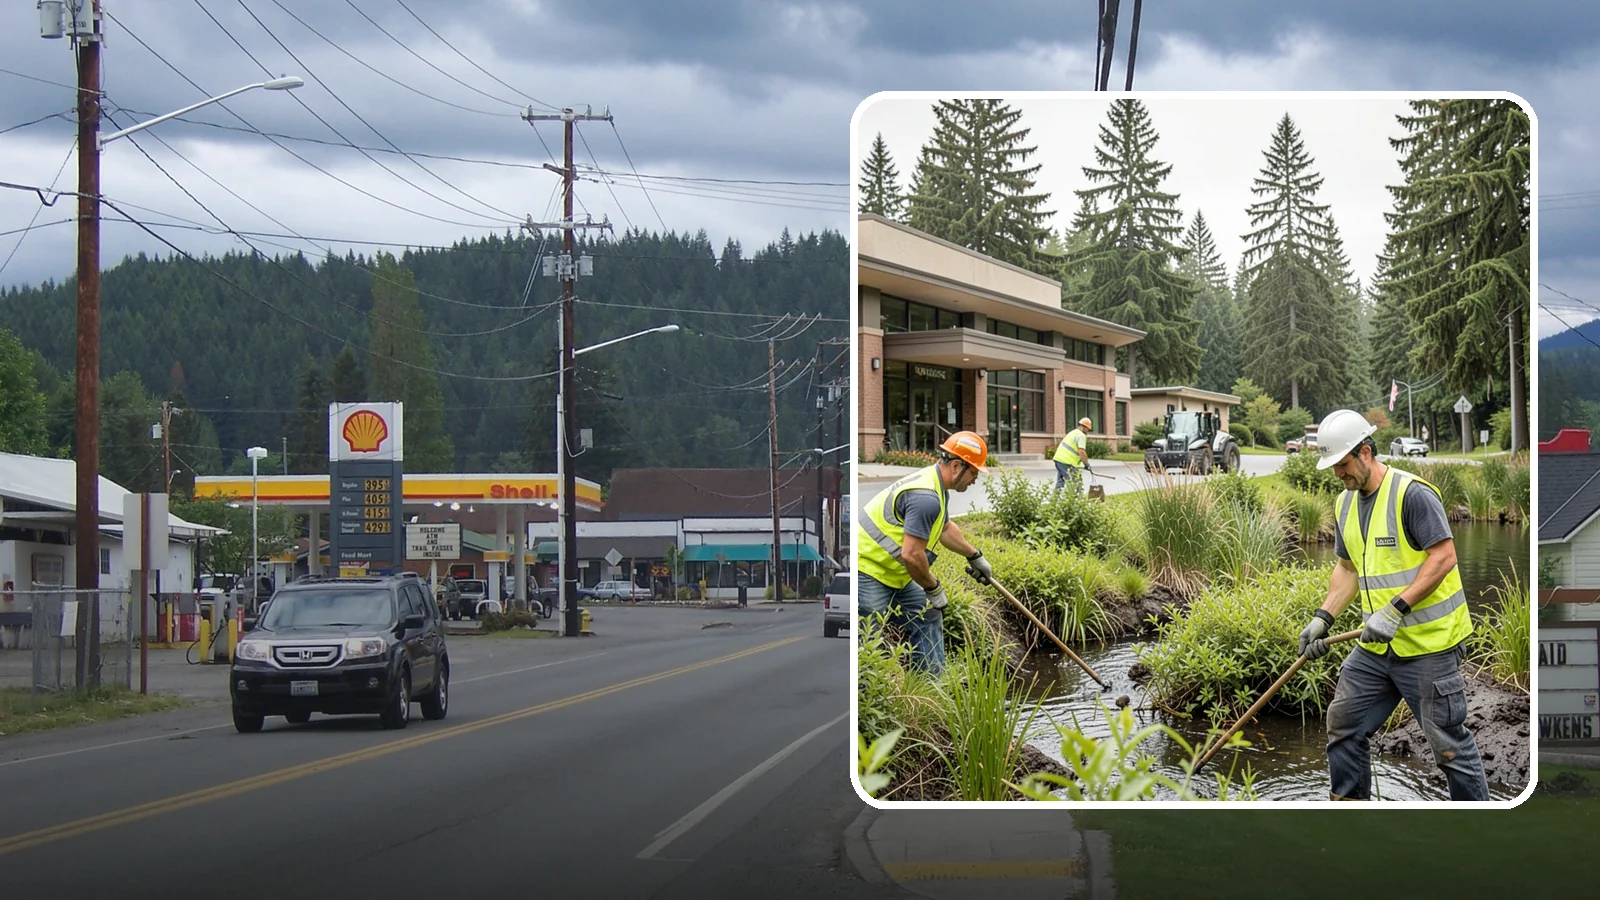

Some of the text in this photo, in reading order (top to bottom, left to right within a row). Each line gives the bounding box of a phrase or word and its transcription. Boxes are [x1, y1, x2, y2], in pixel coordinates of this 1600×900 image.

[366, 479, 383, 490] 395
[490, 484, 547, 499] Shell
[366, 494, 383, 504] 405
[366, 507, 383, 518] 415
[366, 522, 383, 533] 429
[1538, 642, 1566, 665] AID
